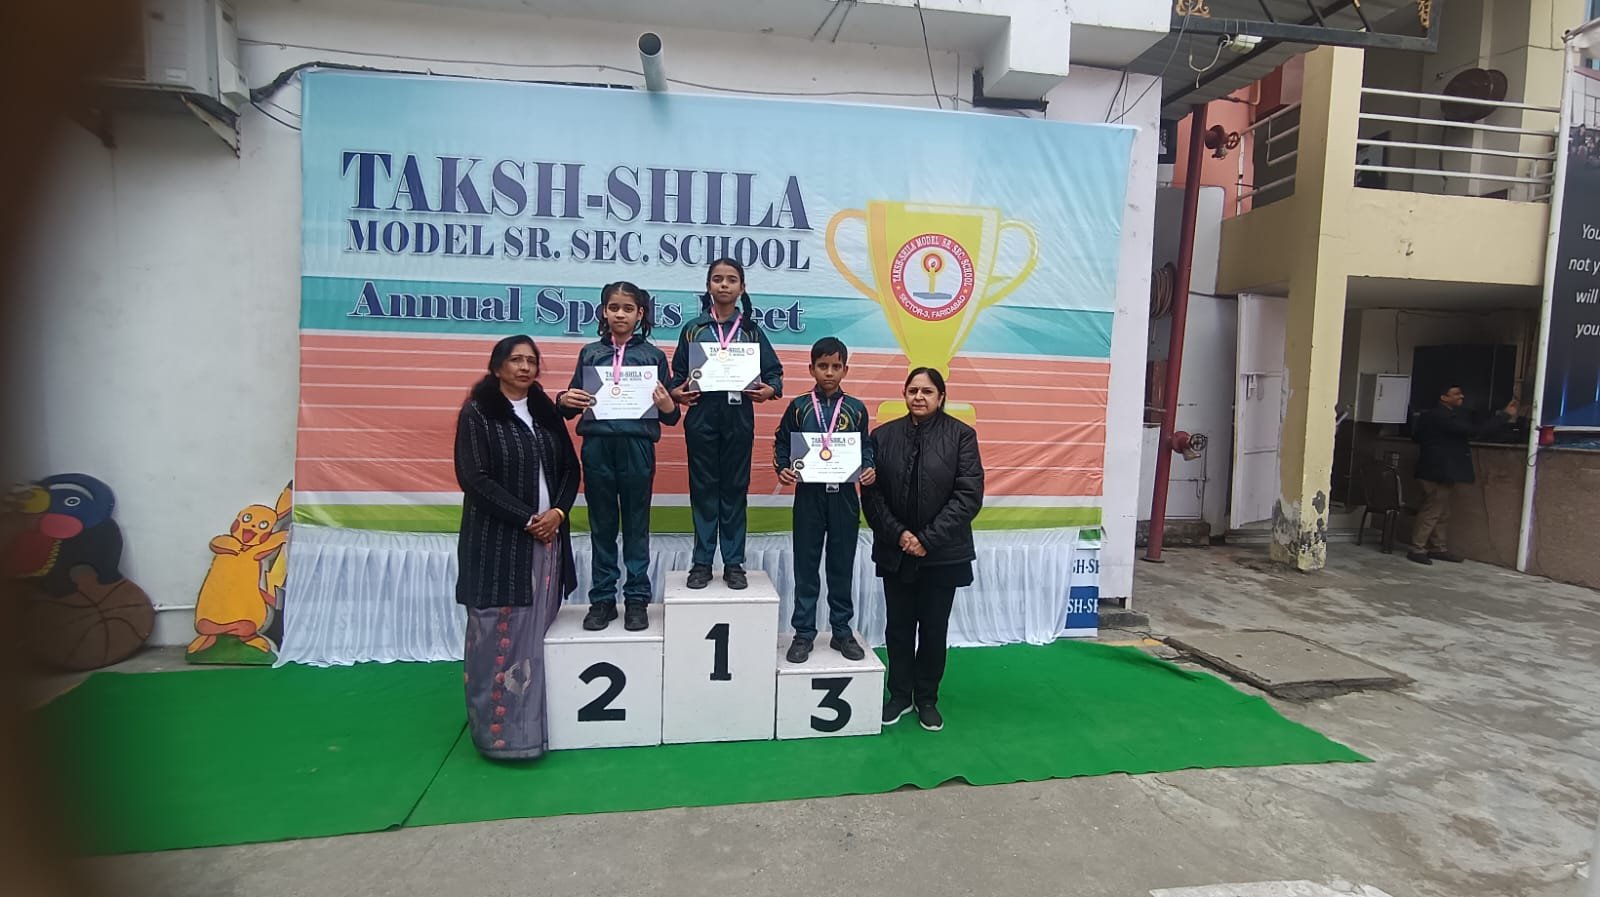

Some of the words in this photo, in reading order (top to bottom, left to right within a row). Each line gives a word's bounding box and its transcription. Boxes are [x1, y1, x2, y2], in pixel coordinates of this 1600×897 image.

[342, 150, 814, 231] TAKSH-SHILA
[345, 219, 494, 257] MODEL
[503, 227, 560, 259] SR.
[571, 230, 649, 263] SEC.
[659, 233, 811, 271] SCHOOL
[916, 236, 939, 247] MODEL
[961, 259, 972, 286] SCHOOL
[1568, 257, 1590, 272] not
[347, 281, 523, 323] Annual
[694, 292, 806, 333] eet
[932, 295, 966, 317] FARIDABAD
[1575, 288, 1598, 304] will
[705, 623, 732, 681] 1
[578, 662, 627, 722] 2
[810, 677, 853, 732] 3
